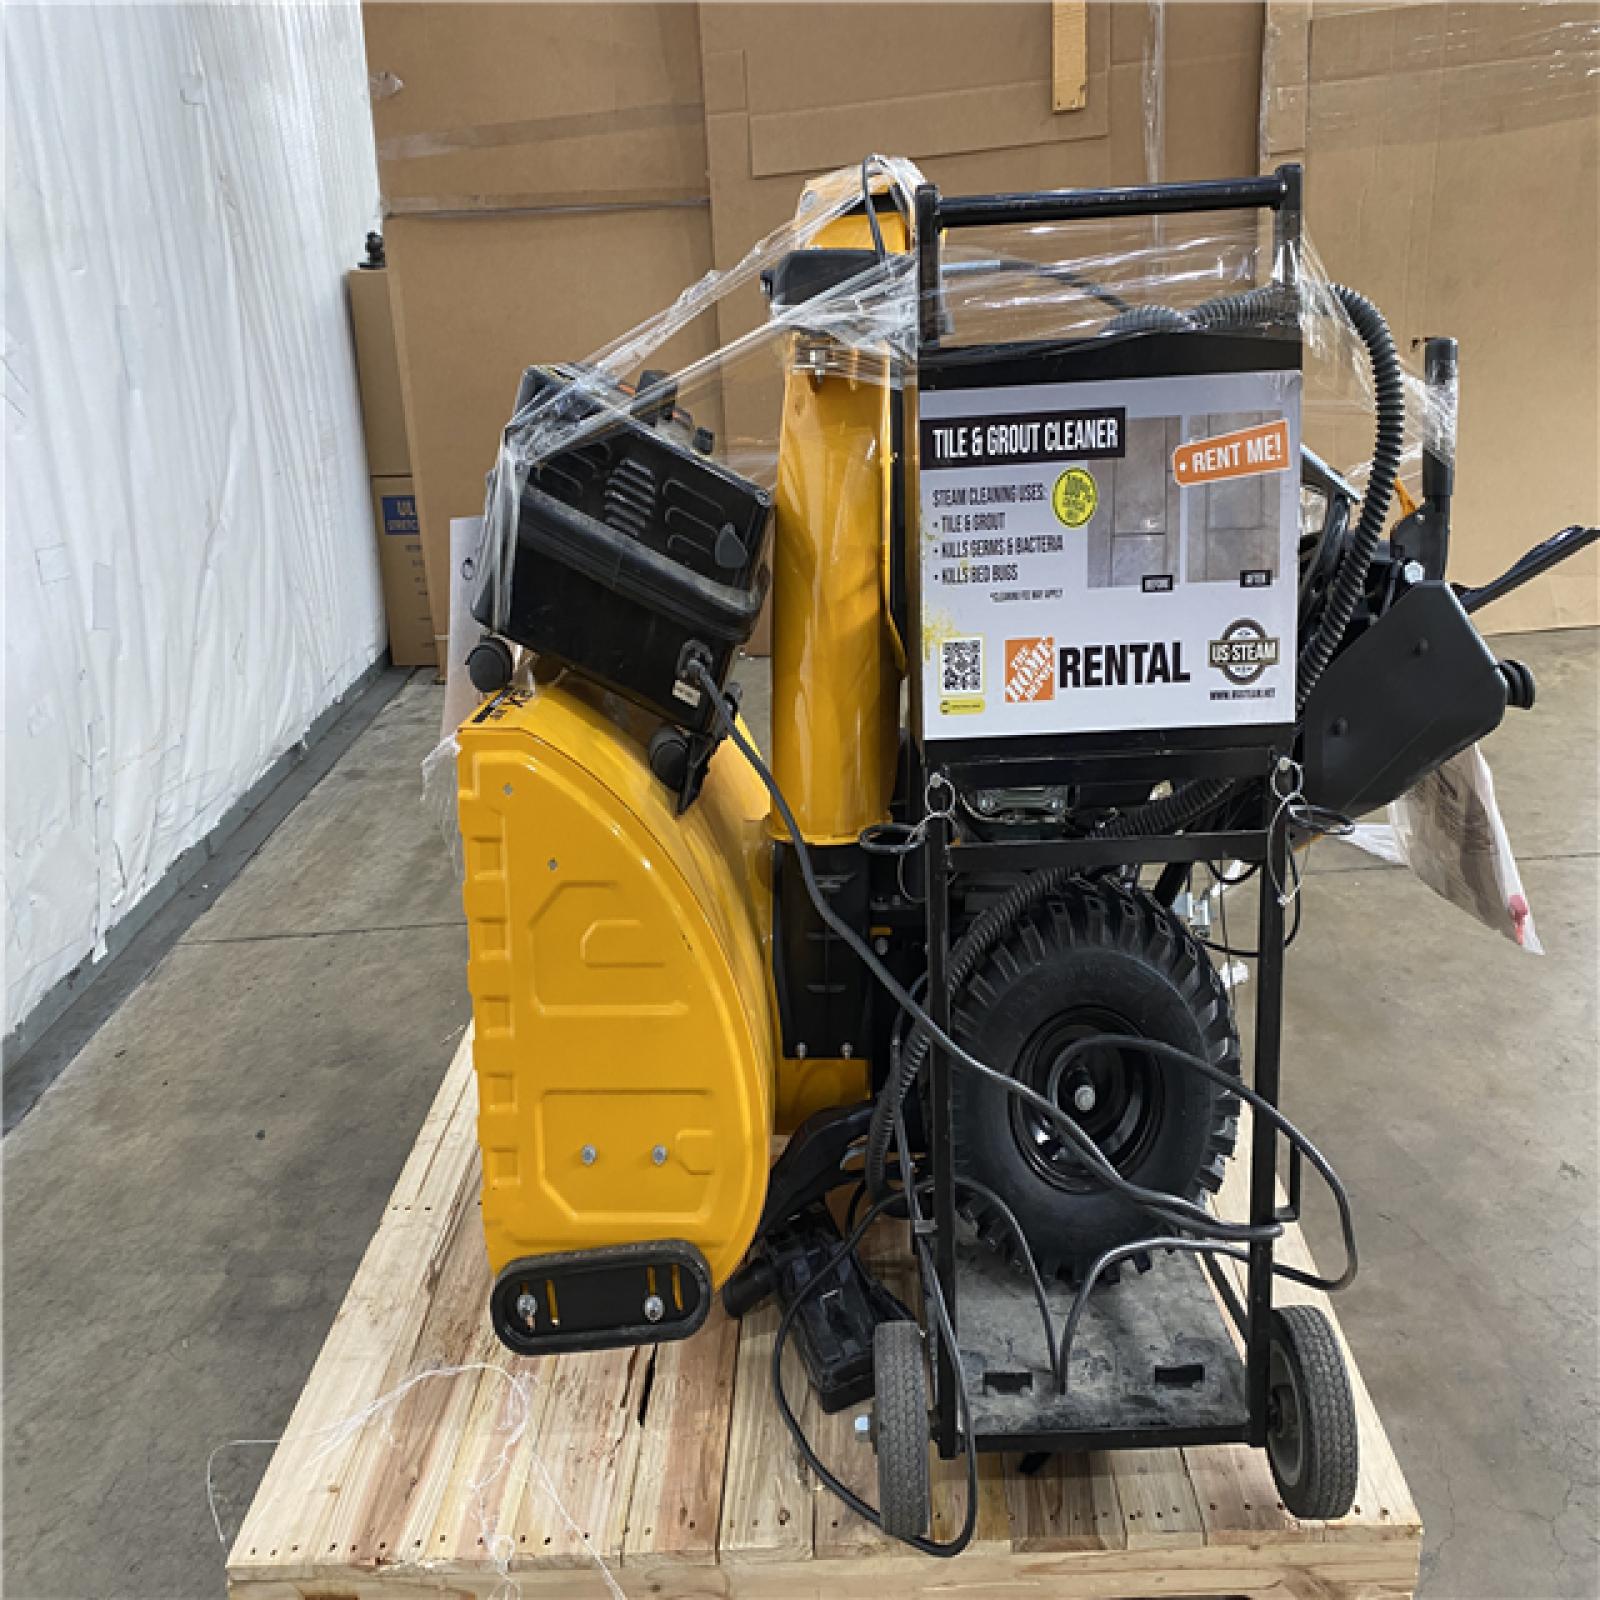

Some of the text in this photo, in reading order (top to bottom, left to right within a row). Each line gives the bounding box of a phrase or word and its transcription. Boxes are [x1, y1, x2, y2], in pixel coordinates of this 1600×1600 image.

[932, 417, 1118, 459] TILE & GROUT CLEANER
[1192, 433, 1281, 473] RENT ME!
[933, 489, 966, 507] STEAM
[969, 485, 1016, 505] CLEANING
[942, 514, 963, 532] TILE
[973, 512, 1006, 531] GROUT
[942, 540, 968, 558] KILLS
[970, 537, 1006, 557] GERMS
[1015, 535, 1064, 555] BACTERIA
[942, 563, 1018, 585] KILLS BED BUGS
[1058, 641, 1191, 689] RENTAL
